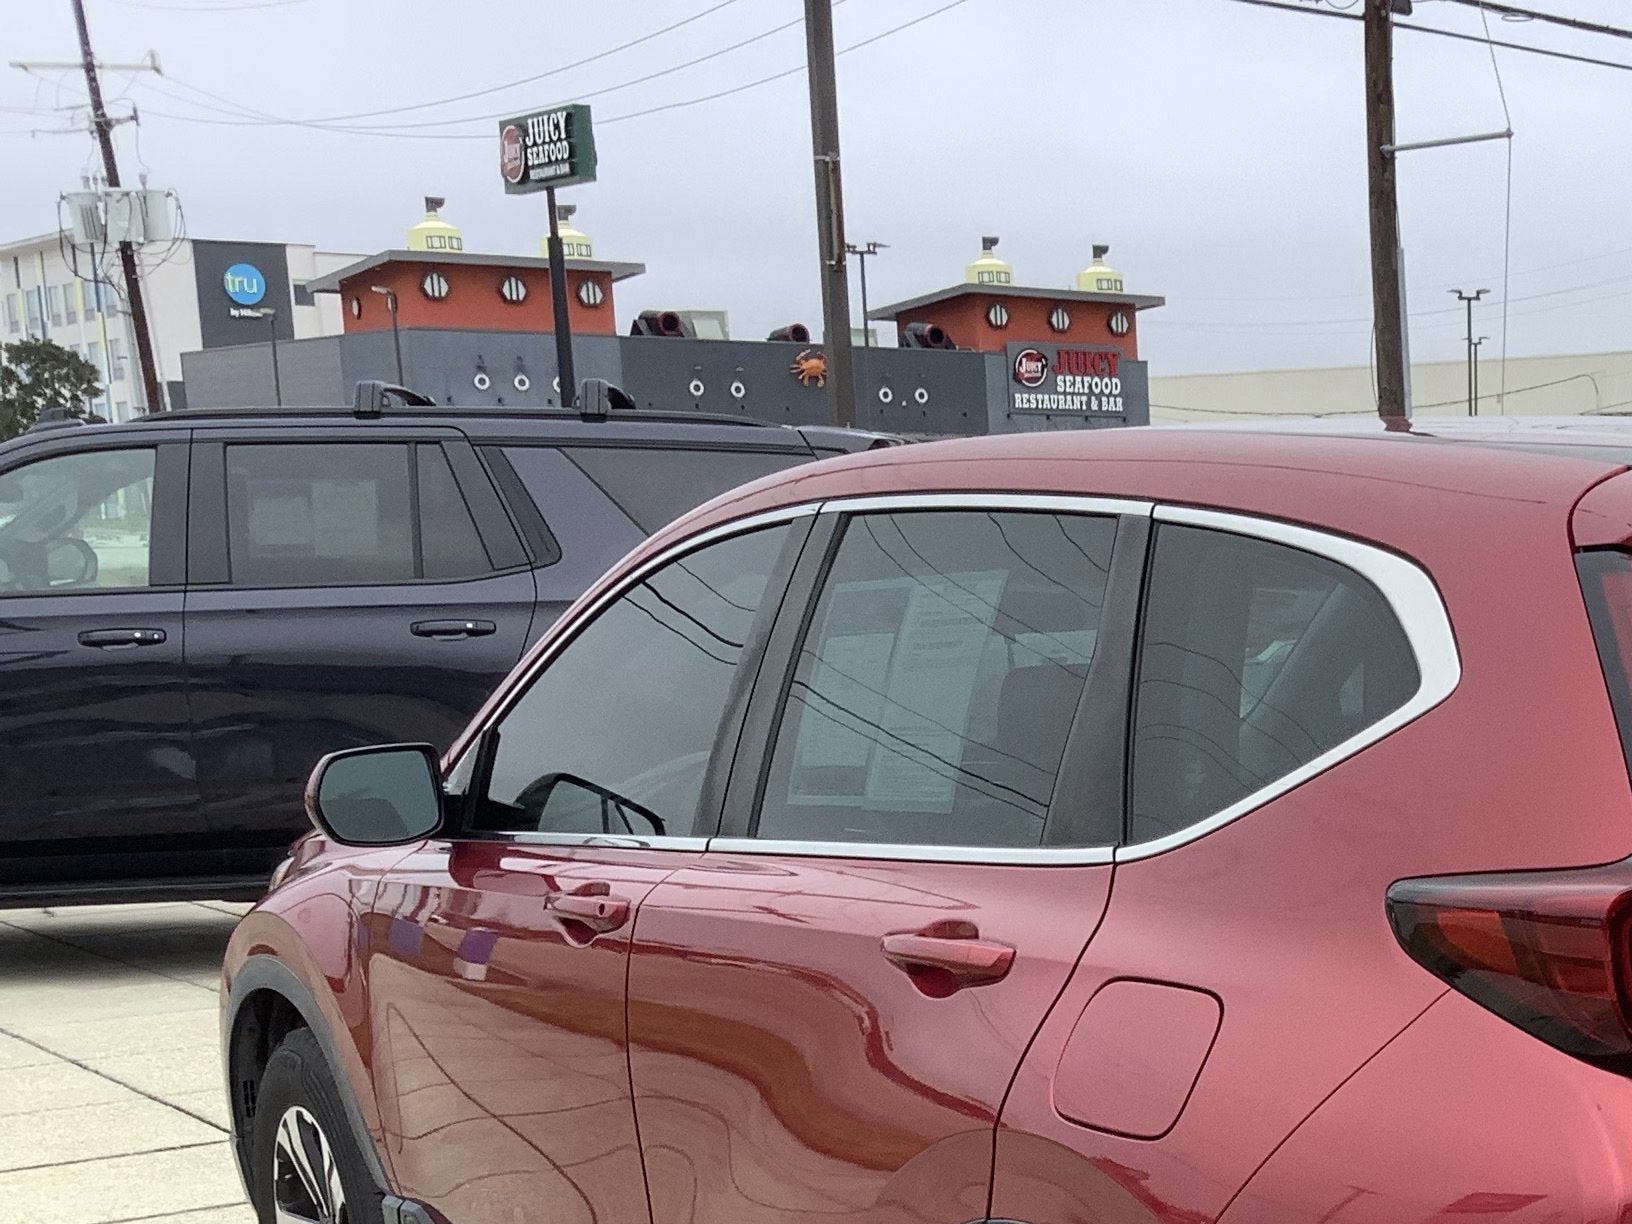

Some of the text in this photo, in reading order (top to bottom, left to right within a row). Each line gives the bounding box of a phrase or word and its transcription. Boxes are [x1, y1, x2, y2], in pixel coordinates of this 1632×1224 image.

[525, 111, 567, 146] JUICY
[527, 140, 570, 166] SEAFOOD
[224, 272, 258, 293] tru
[1052, 349, 1120, 376] JUICY
[1056, 375, 1121, 394] SEAFOOD
[1014, 393, 1123, 411] RESTAURANT & BAR
